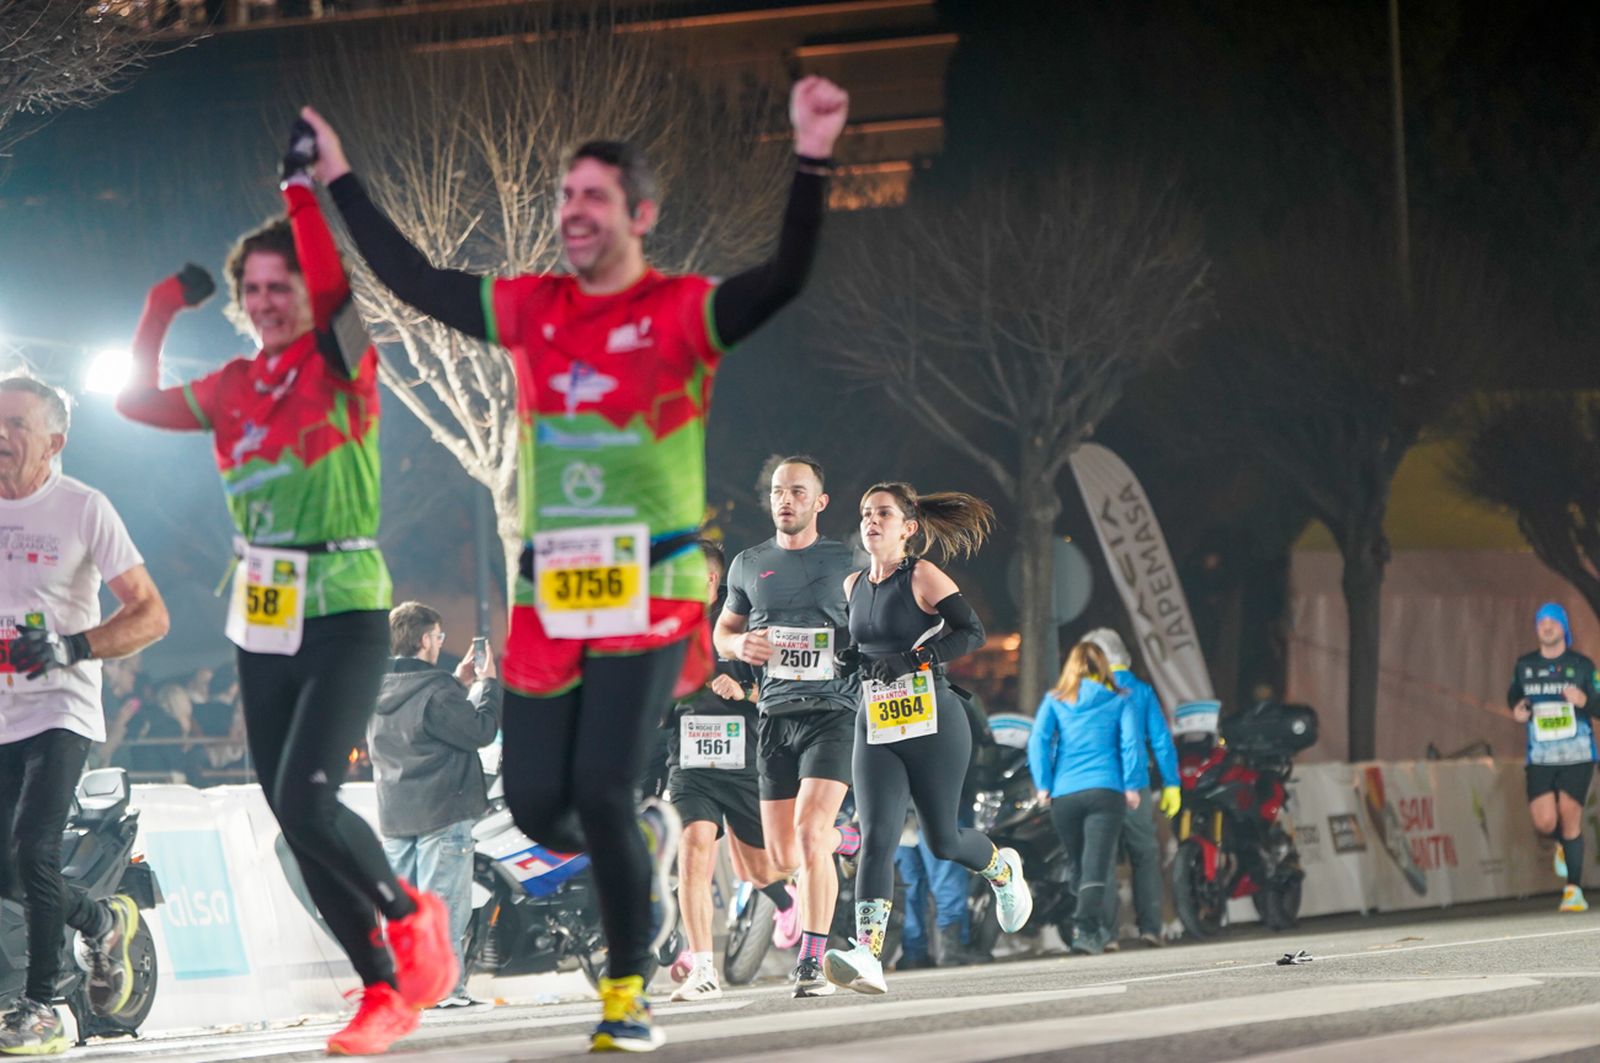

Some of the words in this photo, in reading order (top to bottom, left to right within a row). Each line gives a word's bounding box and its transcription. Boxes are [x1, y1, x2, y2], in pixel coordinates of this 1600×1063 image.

[1119, 483, 1197, 653] JAPEMASA
[555, 568, 623, 600] 3756
[780, 649, 820, 668] 2507
[898, 681, 906, 689] DE
[878, 695, 924, 721] 3964
[695, 739, 731, 755] 1561
[1399, 797, 1434, 832] SAN
[164, 885, 232, 928] alsa
